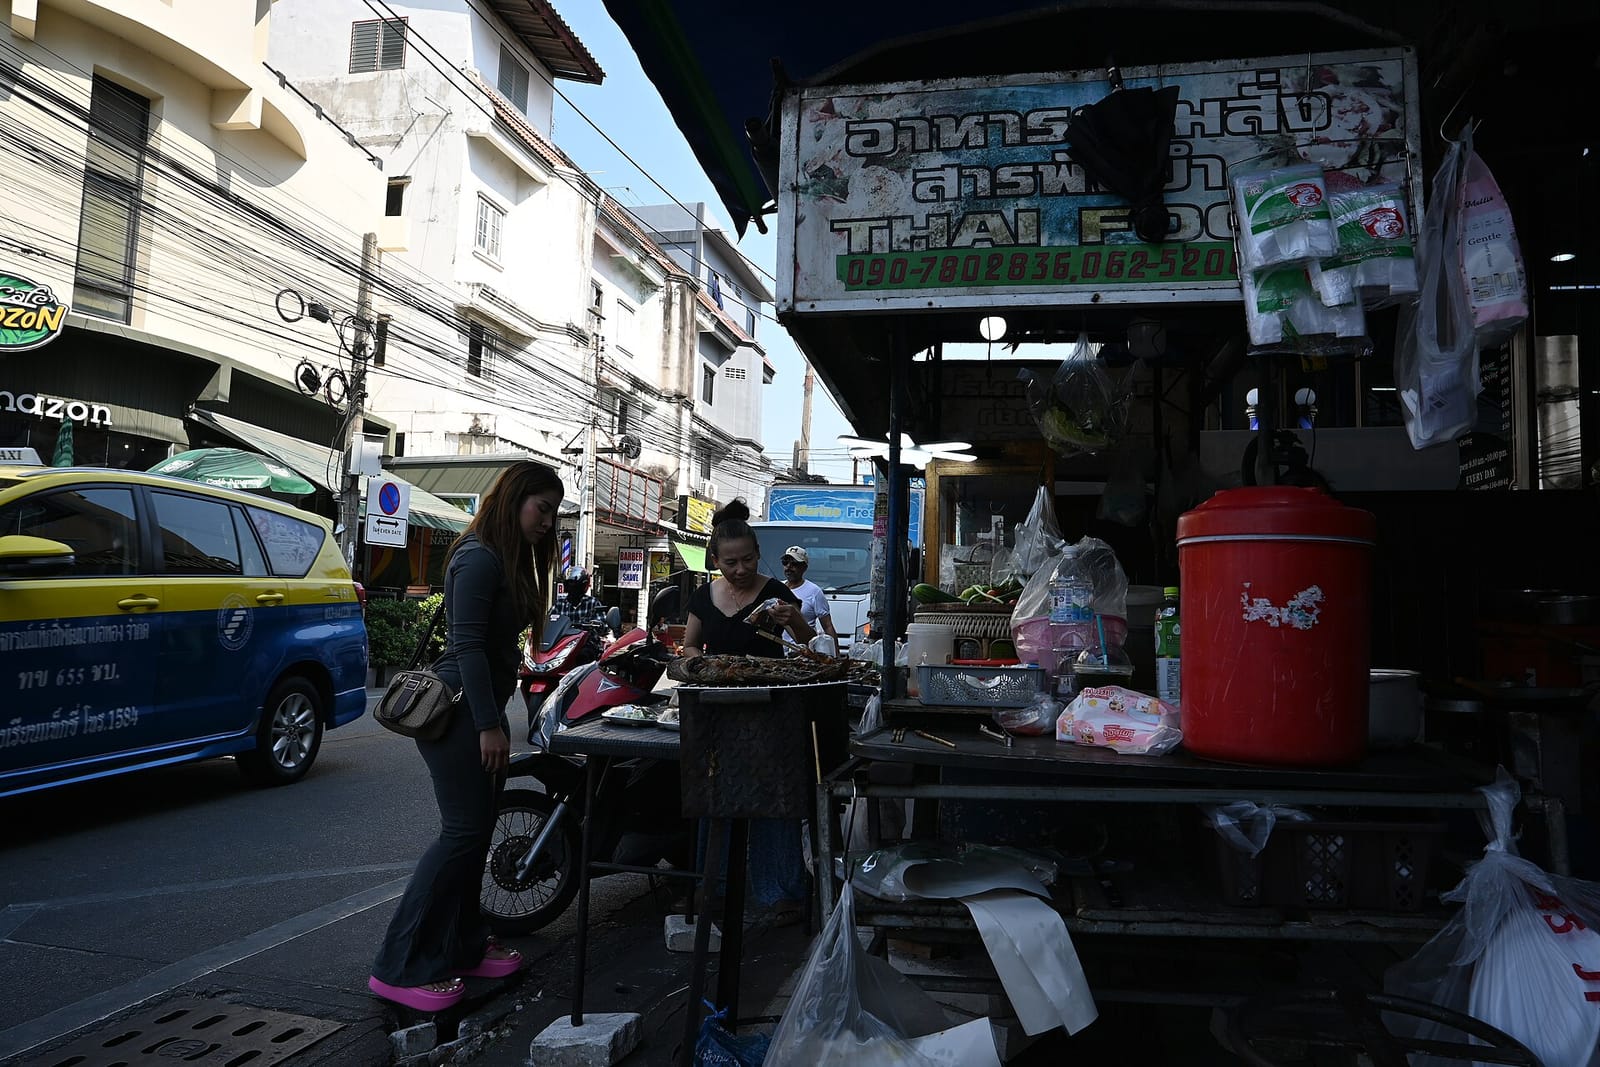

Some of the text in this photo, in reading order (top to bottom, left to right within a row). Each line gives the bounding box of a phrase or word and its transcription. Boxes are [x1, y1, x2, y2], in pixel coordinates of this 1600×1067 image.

[830, 207, 1040, 256] THAI
[1467, 232, 1502, 246] Gentle
[1465, 471, 1484, 486] EVERY
[1484, 466, 1497, 480] DAY
[795, 504, 874, 518] Marine Fres
[620, 551, 643, 561] BARBER
[620, 563, 631, 572] HAIR
[623, 573, 639, 582] SHAVE
[56, 667, 86, 687] 655
